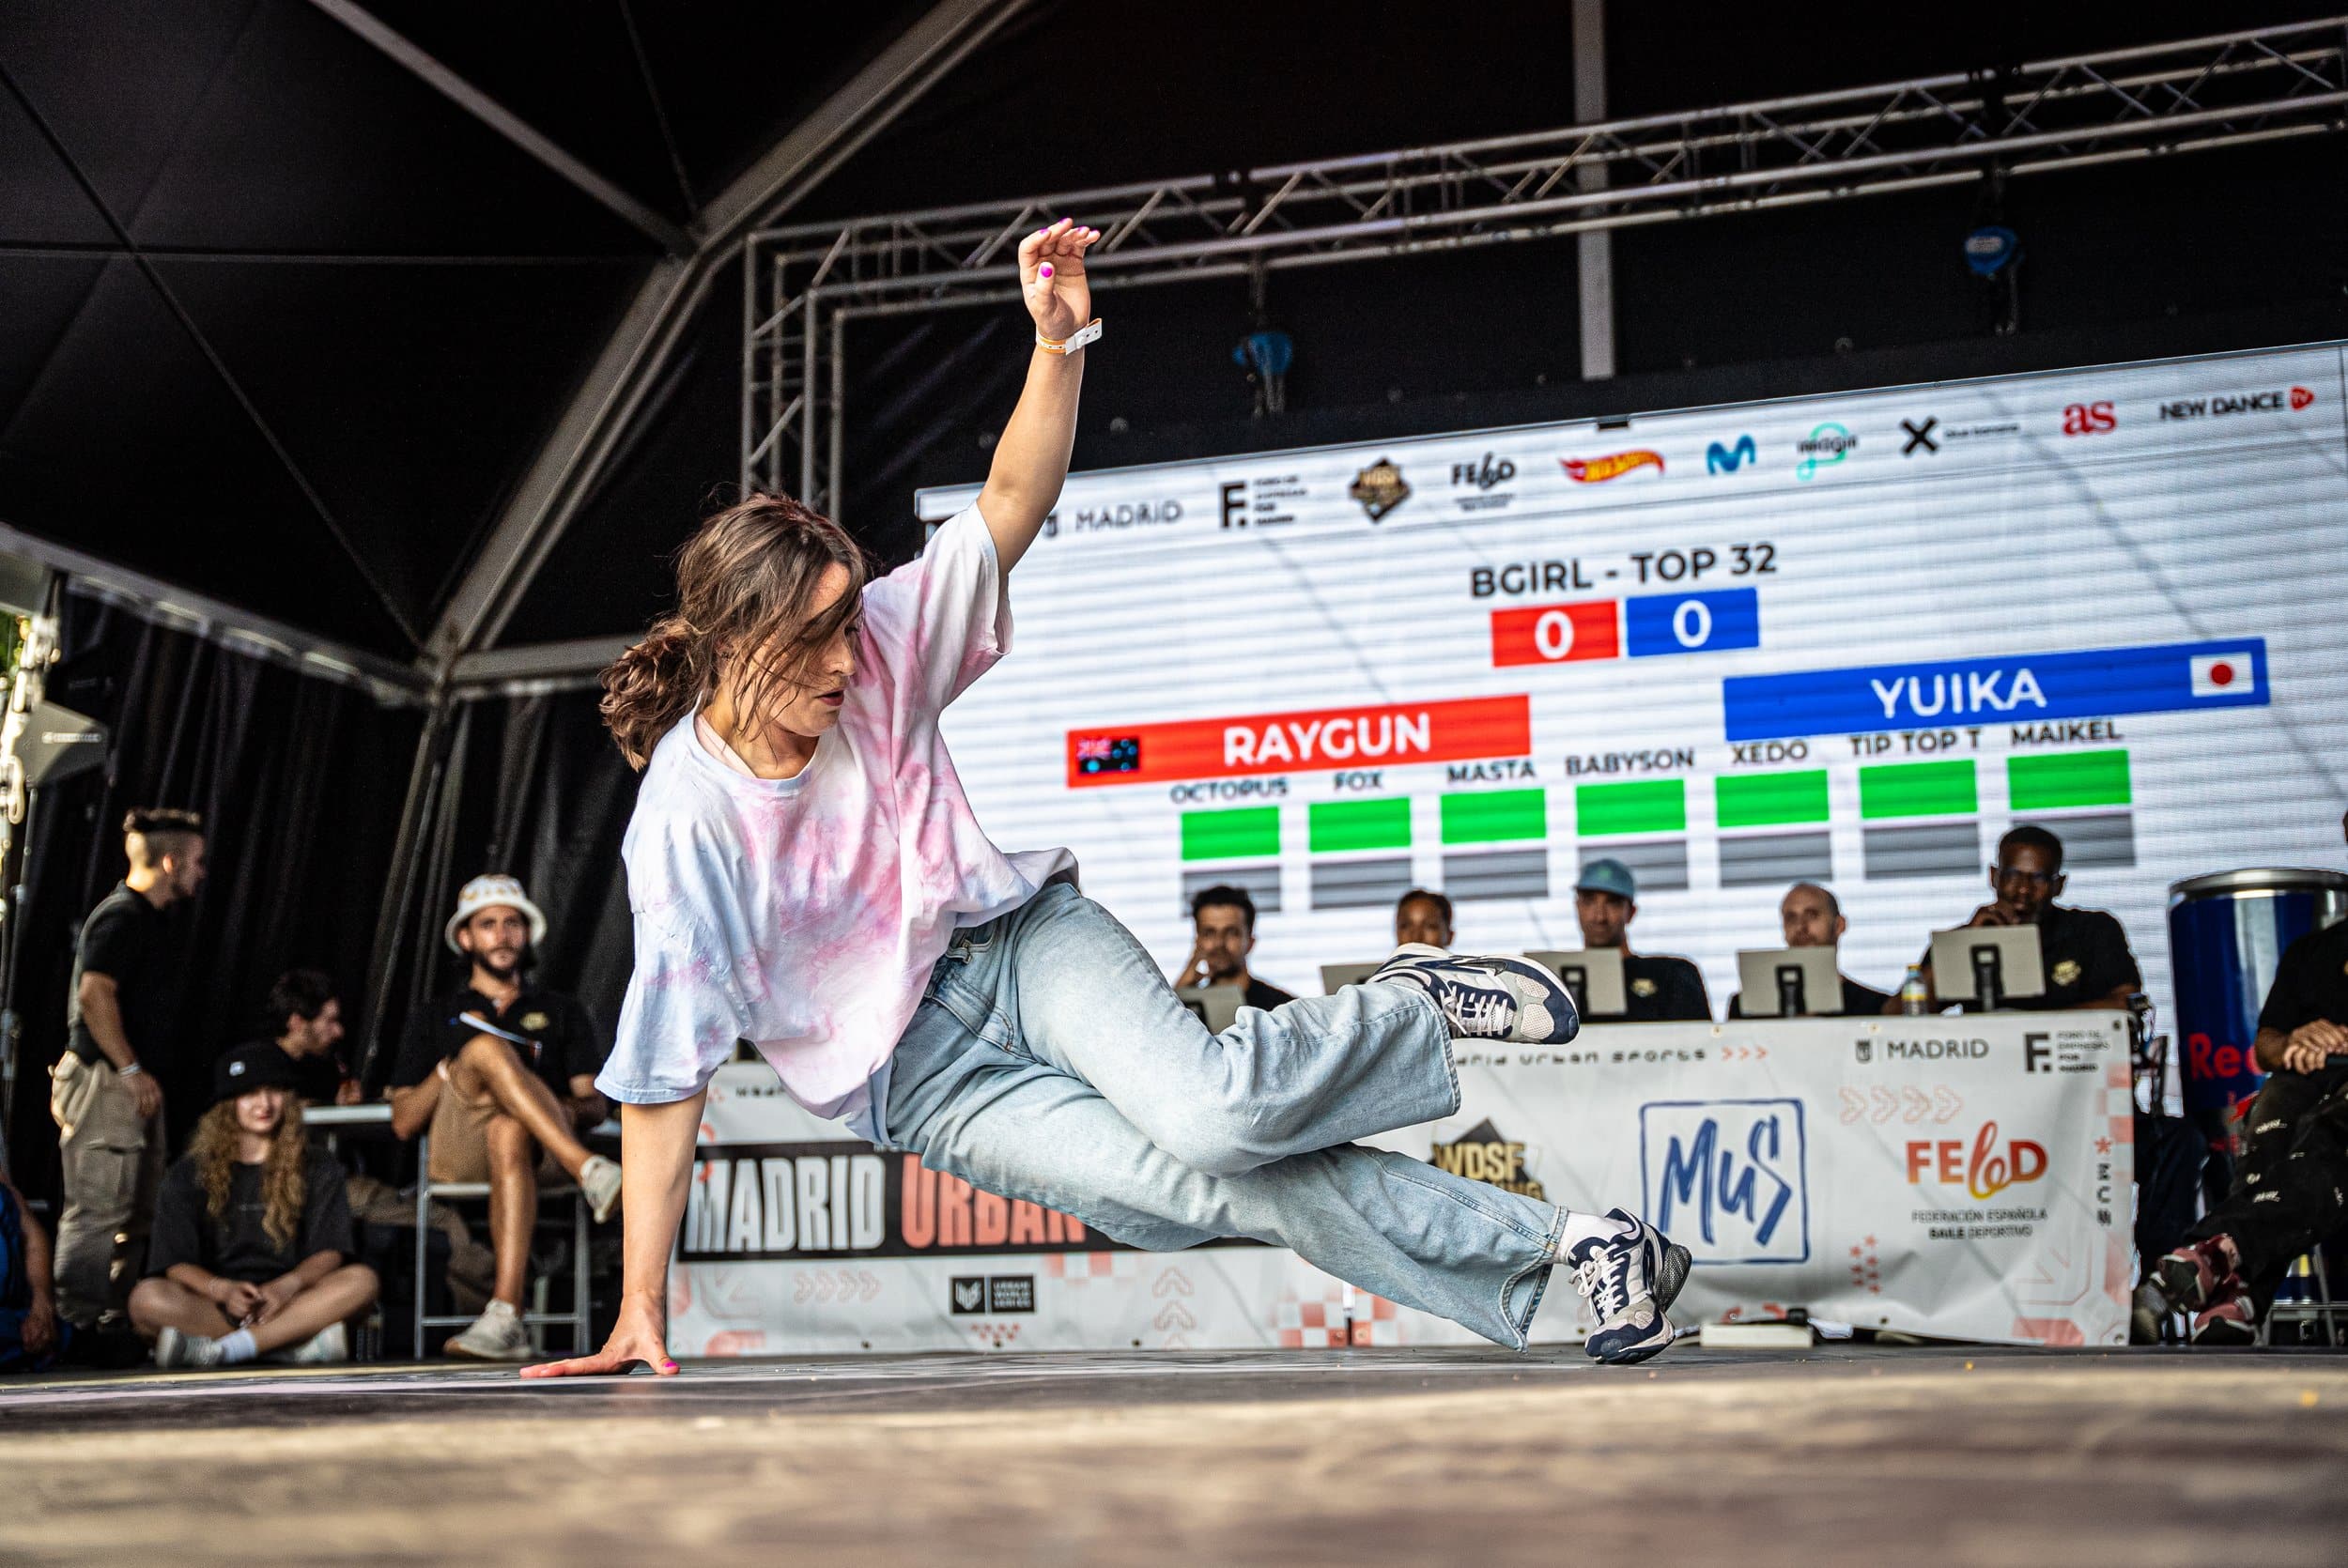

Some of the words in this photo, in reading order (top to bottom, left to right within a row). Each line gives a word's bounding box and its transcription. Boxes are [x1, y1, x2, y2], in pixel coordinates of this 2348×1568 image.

[2062, 401, 2117, 437] as
[2159, 399, 2205, 421] NEW
[2212, 391, 2285, 416] DANCE
[1075, 500, 1183, 532] MADRID
[1471, 557, 1594, 598] BGIRL
[1630, 547, 1717, 585] TOP
[1731, 543, 1778, 576] 32
[1535, 610, 1575, 660] 0
[1673, 599, 1712, 648] 0
[1870, 668, 2048, 720] YUIKA
[1223, 712, 1431, 767] RAYGUN
[1849, 733, 1892, 757] TIP
[1900, 729, 1958, 752] TOP
[1966, 726, 1982, 749] T
[2009, 719, 2125, 747] MAIKEL
[1564, 747, 1695, 776] BABYSON
[1732, 740, 1809, 765] XEDO
[1334, 770, 1385, 792] FOX
[1445, 760, 1538, 785] MASTA
[1169, 776, 1290, 806] OCTOPUS
[1887, 1038, 1990, 1060] MADRID
[1432, 1141, 1525, 1181] WDSF
[683, 1154, 887, 1253] MADRID
